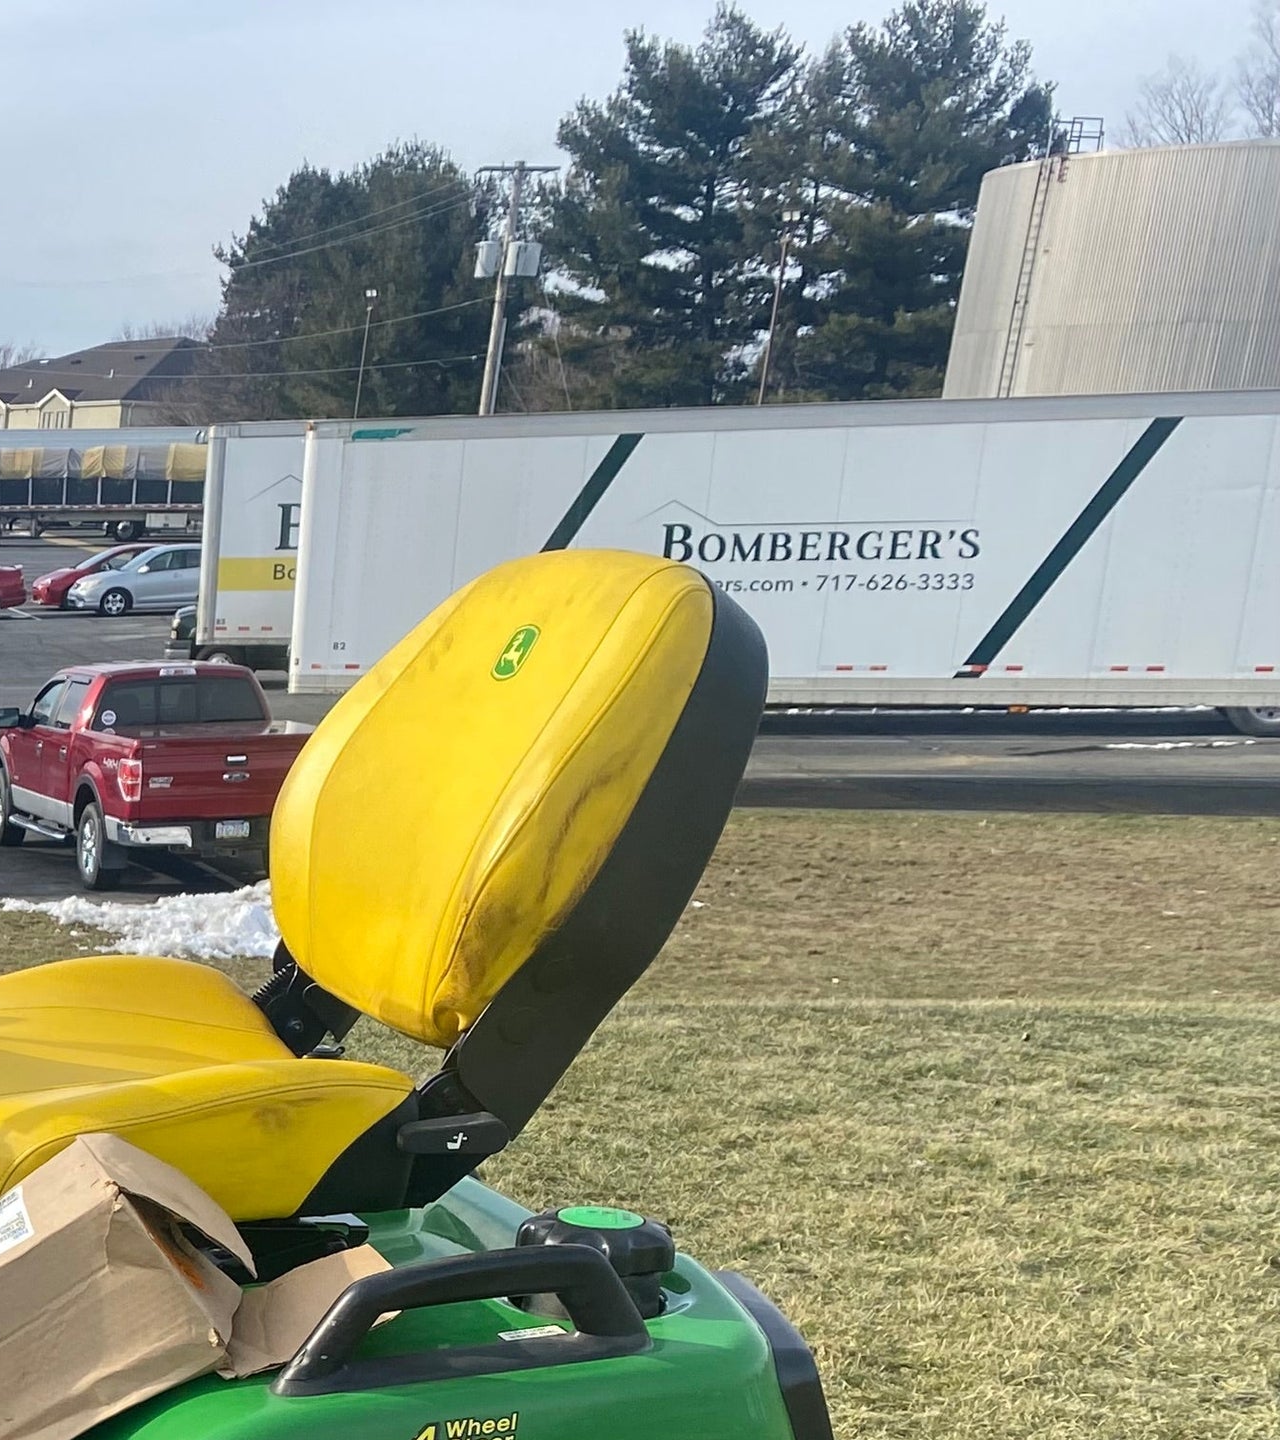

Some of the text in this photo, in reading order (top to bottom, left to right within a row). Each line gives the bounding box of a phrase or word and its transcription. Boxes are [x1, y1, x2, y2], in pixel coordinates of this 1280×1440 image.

[662, 523, 981, 563] BOMBERGER'S
[816, 573, 975, 592] 717-626-3333
[446, 1412, 518, 1438] Wheel
